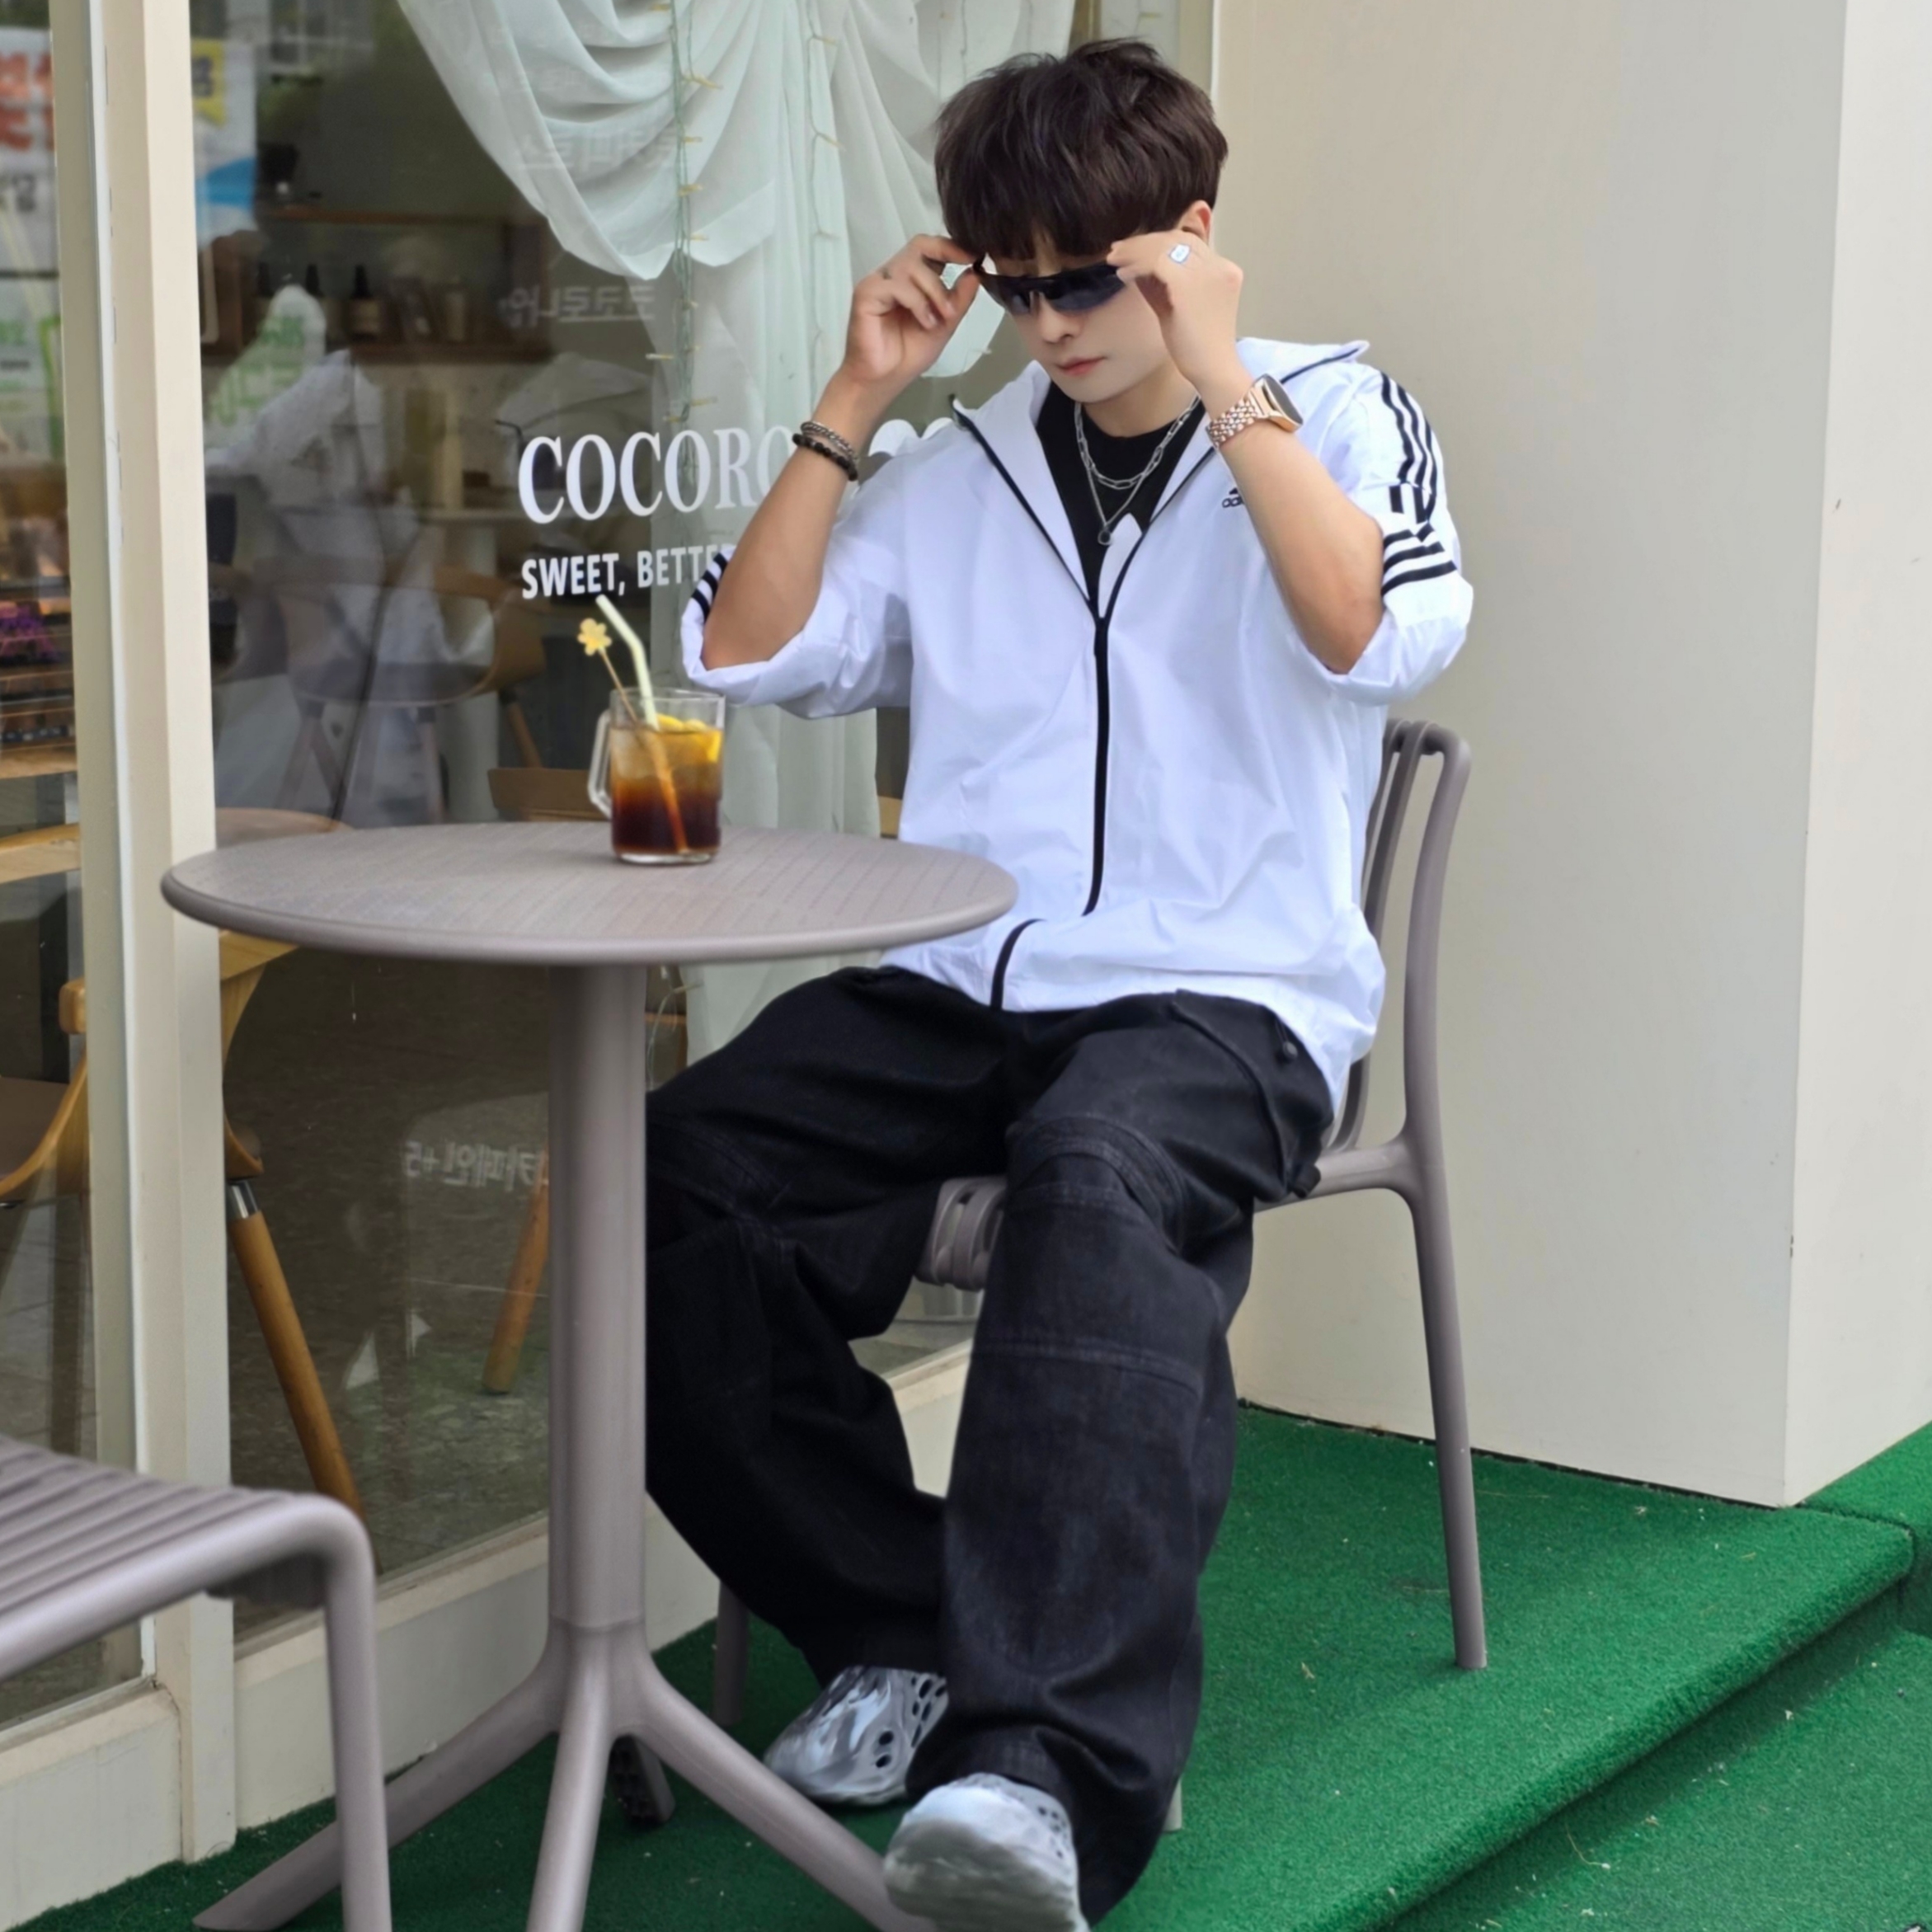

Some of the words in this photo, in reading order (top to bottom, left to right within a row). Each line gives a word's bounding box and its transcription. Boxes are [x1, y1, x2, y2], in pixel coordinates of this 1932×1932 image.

[519, 425, 798, 524] COCORO
[521, 552, 626, 599] SWEET,
[637, 544, 734, 589] BETTE
